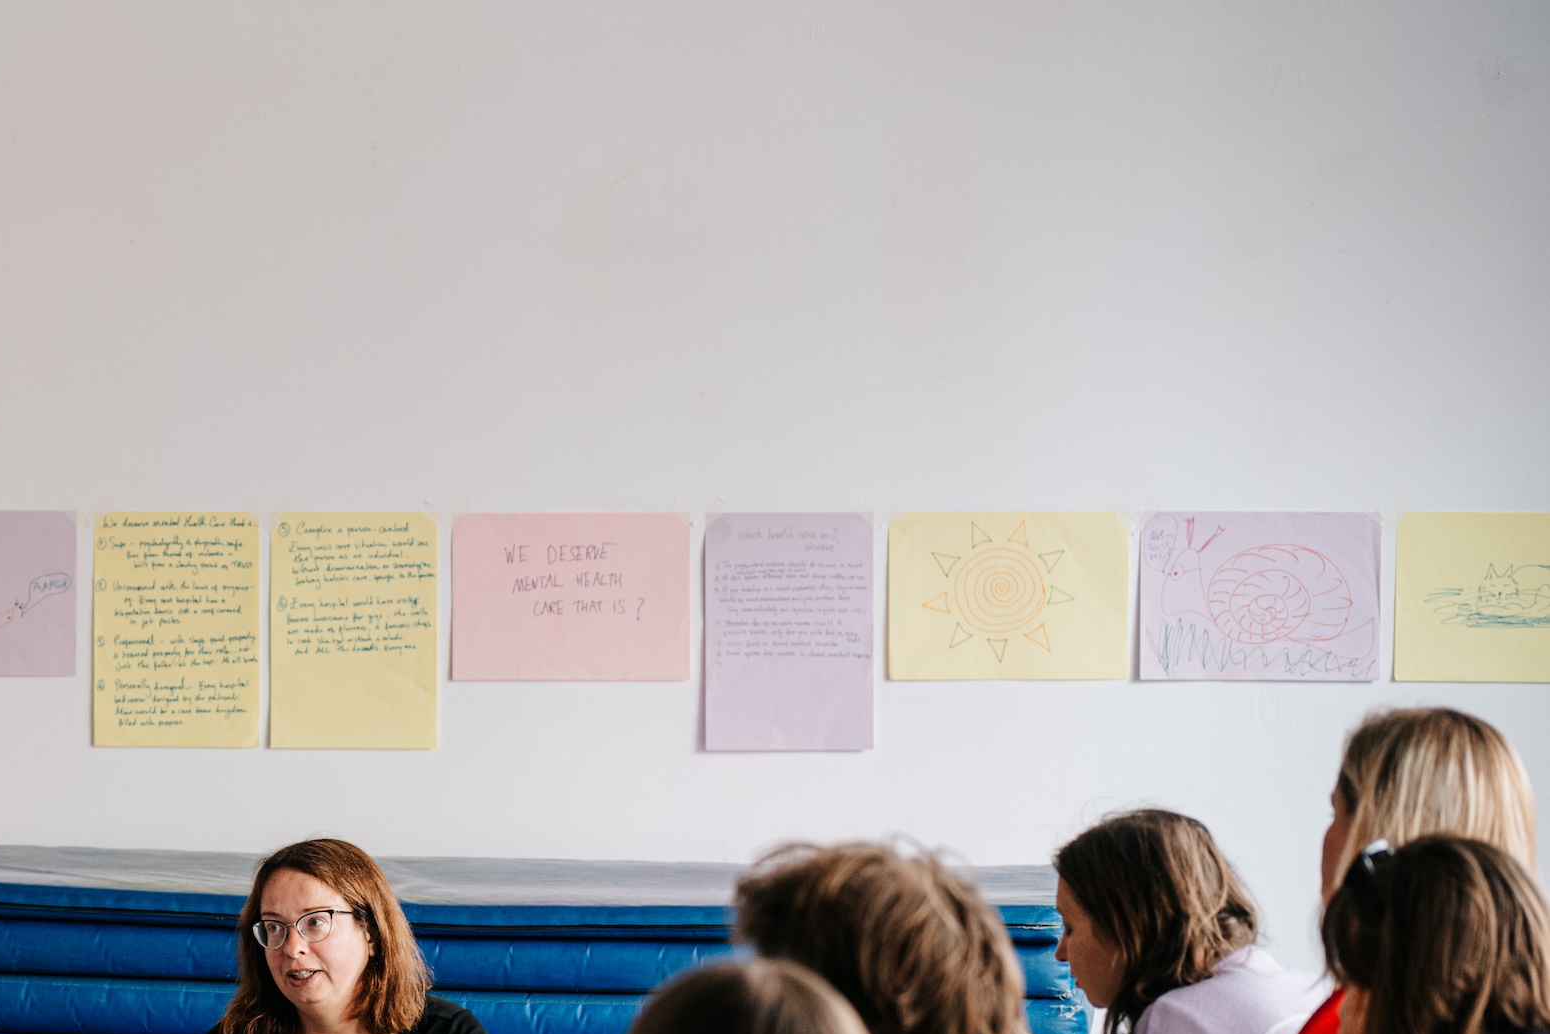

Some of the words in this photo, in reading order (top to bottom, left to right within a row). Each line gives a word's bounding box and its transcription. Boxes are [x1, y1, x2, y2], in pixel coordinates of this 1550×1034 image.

[504, 543, 529, 564] WE
[547, 542, 617, 565] DESERVE
[512, 573, 565, 595] MENTAL
[576, 570, 622, 588] HEALTH
[533, 599, 565, 617] CARE
[572, 599, 603, 614] THAT
[613, 599, 626, 615] IS
[636, 597, 646, 622] ?
